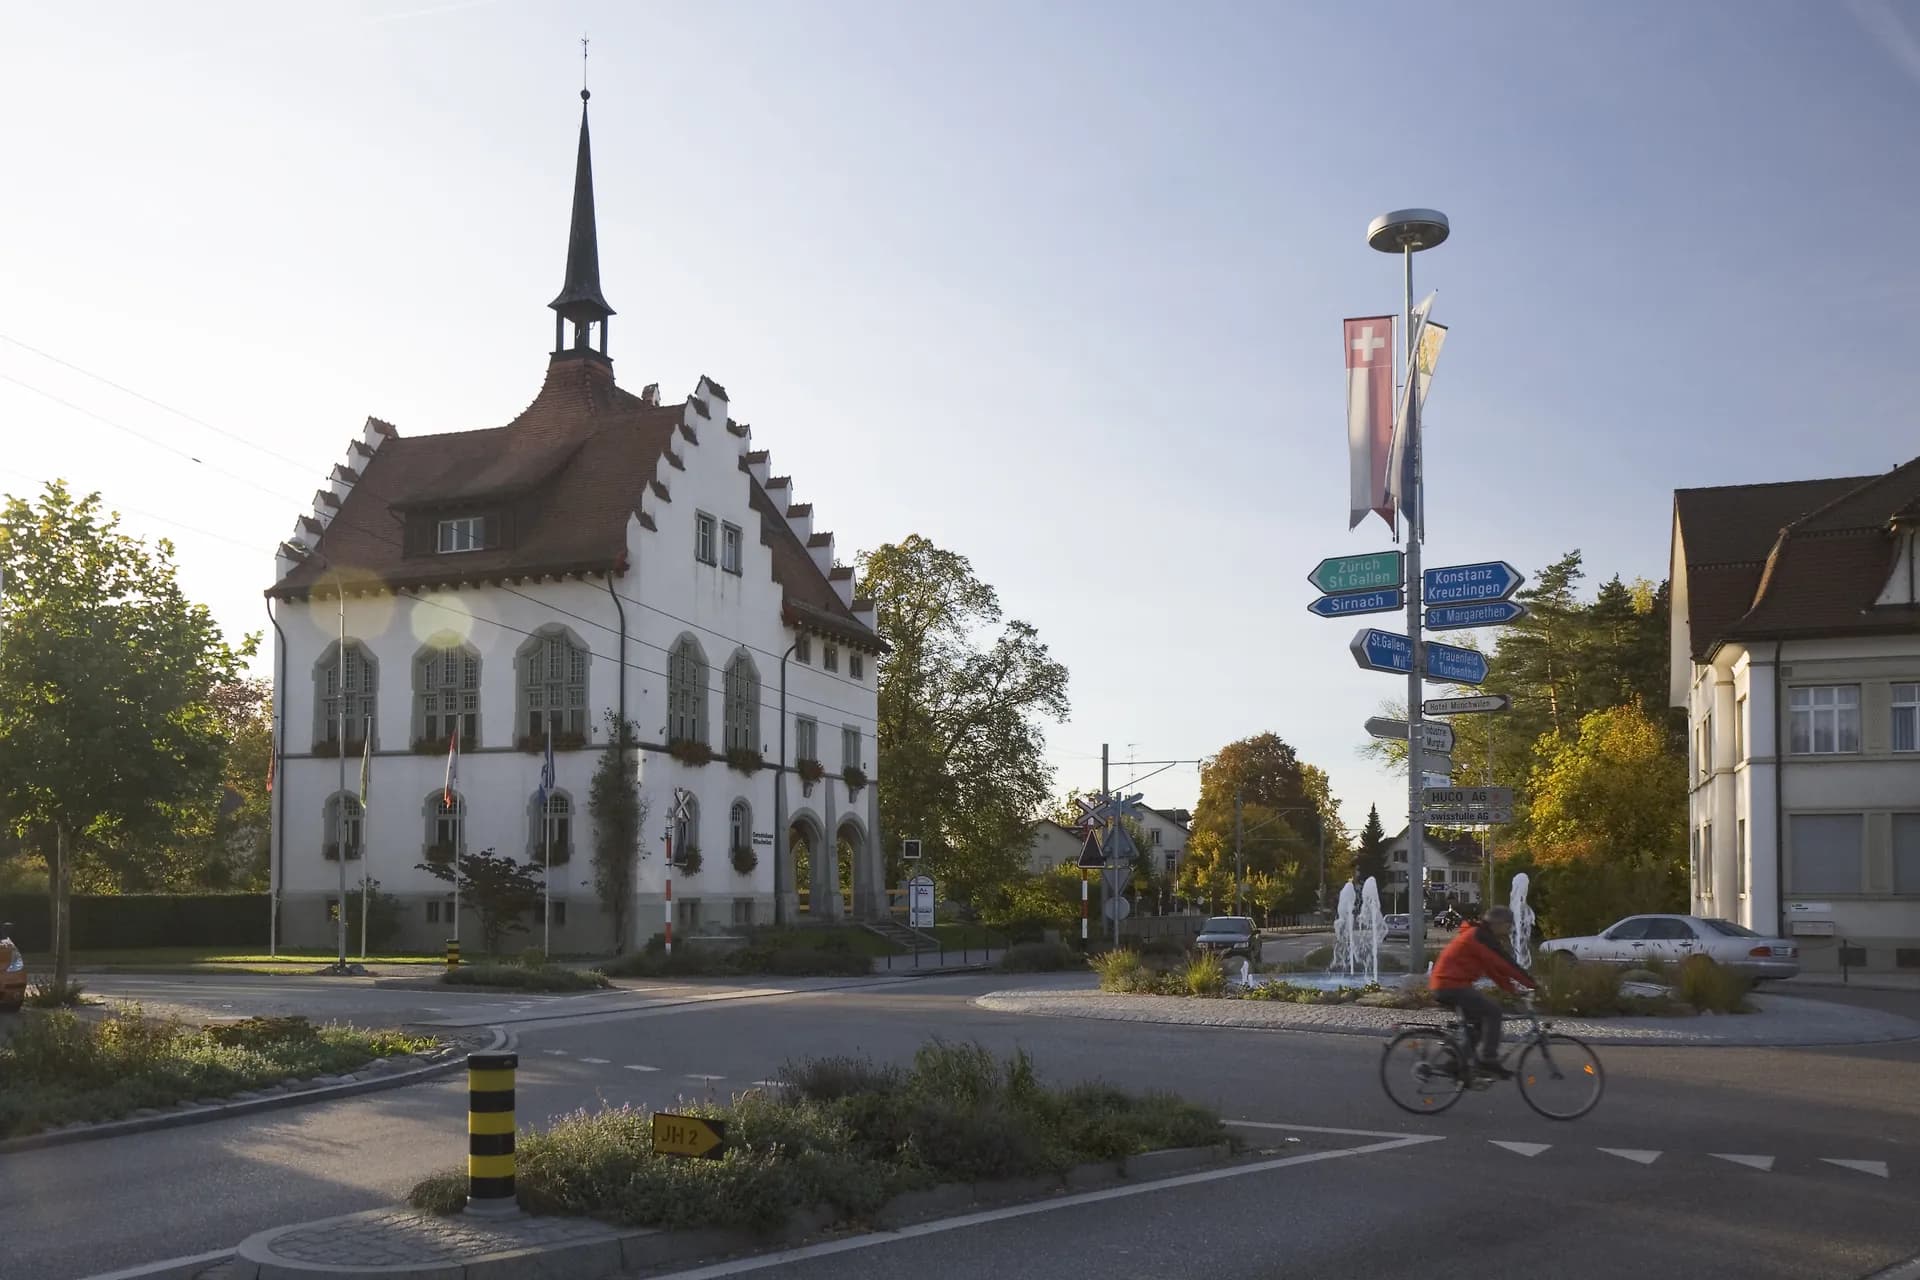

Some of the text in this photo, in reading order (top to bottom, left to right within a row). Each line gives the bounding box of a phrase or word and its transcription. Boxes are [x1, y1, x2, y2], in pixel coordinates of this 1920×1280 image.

[1338, 559, 1380, 574] Zürich
[1329, 572, 1390, 588] St. Gallen
[1435, 569, 1492, 585] Konstanz
[1428, 583, 1500, 600] Kreuzlingen
[1331, 594, 1384, 611] Sirnach
[1447, 607, 1505, 623] Margarethen
[1393, 654, 1406, 668] Wil
[1439, 648, 1478, 666] Frauenfeld
[1439, 662, 1480, 680] Turbenthal
[1430, 703, 1448, 711] Hotel
[1432, 791, 1487, 802] HUCO AG
[1477, 812, 1489, 821] AG
[662, 1125, 698, 1145] JH 2
